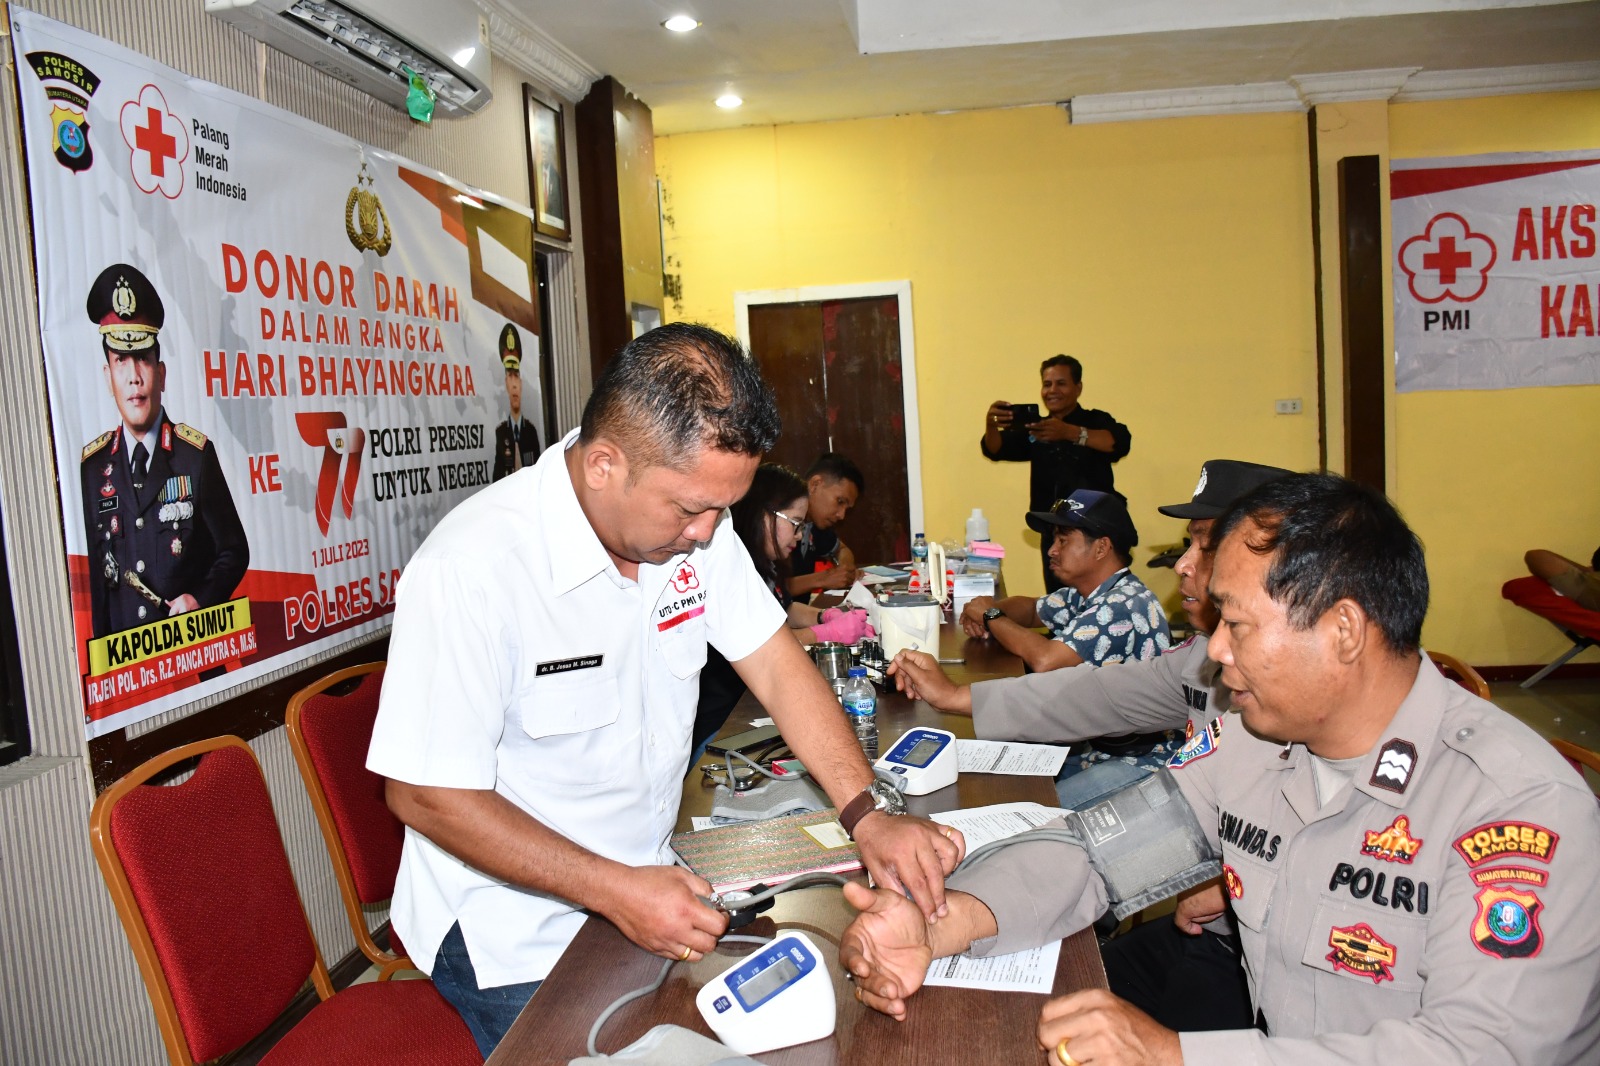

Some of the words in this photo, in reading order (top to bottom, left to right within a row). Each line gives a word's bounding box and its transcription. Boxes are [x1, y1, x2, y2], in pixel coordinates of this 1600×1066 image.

[36, 66, 93, 93] SAMOSIR
[43, 56, 84, 77] POLRES
[192, 118, 230, 150] Palang
[195, 145, 229, 172] Merah
[195, 171, 248, 201] Indonesia
[1512, 204, 1596, 262] AKS
[221, 243, 357, 309] DONOR
[373, 271, 460, 323] DARAH
[260, 307, 351, 346] DALAM
[359, 318, 445, 353] RANGKA
[1423, 309, 1471, 332] PMI
[1541, 284, 1600, 339] KA
[203, 350, 288, 398] HARI
[297, 354, 477, 397] BHAYANGKARA
[369, 426, 421, 459] POLRI
[428, 423, 485, 453] PRESISI
[248, 453, 283, 495] KE
[371, 466, 433, 503] UNTUK
[437, 459, 491, 492] NEGERI
[311, 550, 318, 569] 1
[320, 543, 344, 567] JULI
[346, 538, 370, 559] 2023
[284, 576, 373, 640] POLRES
[680, 595, 697, 609] PMI
[107, 621, 184, 666] KAPOLDA
[187, 605, 235, 640] SUMUT
[87, 677, 116, 706] IRJEN
[117, 670, 139, 695] POL.
[139, 665, 158, 687] Drs.
[158, 656, 175, 681] R.Z.
[176, 648, 203, 675] PANCA
[204, 639, 230, 665] PUTRA
[239, 631, 257, 653] M.Si.
[1461, 826, 1550, 853] POLRES
[1329, 862, 1430, 915] POLRI
[1476, 869, 1516, 883] SUMATERA
[1516, 870, 1542, 883] UTARA
